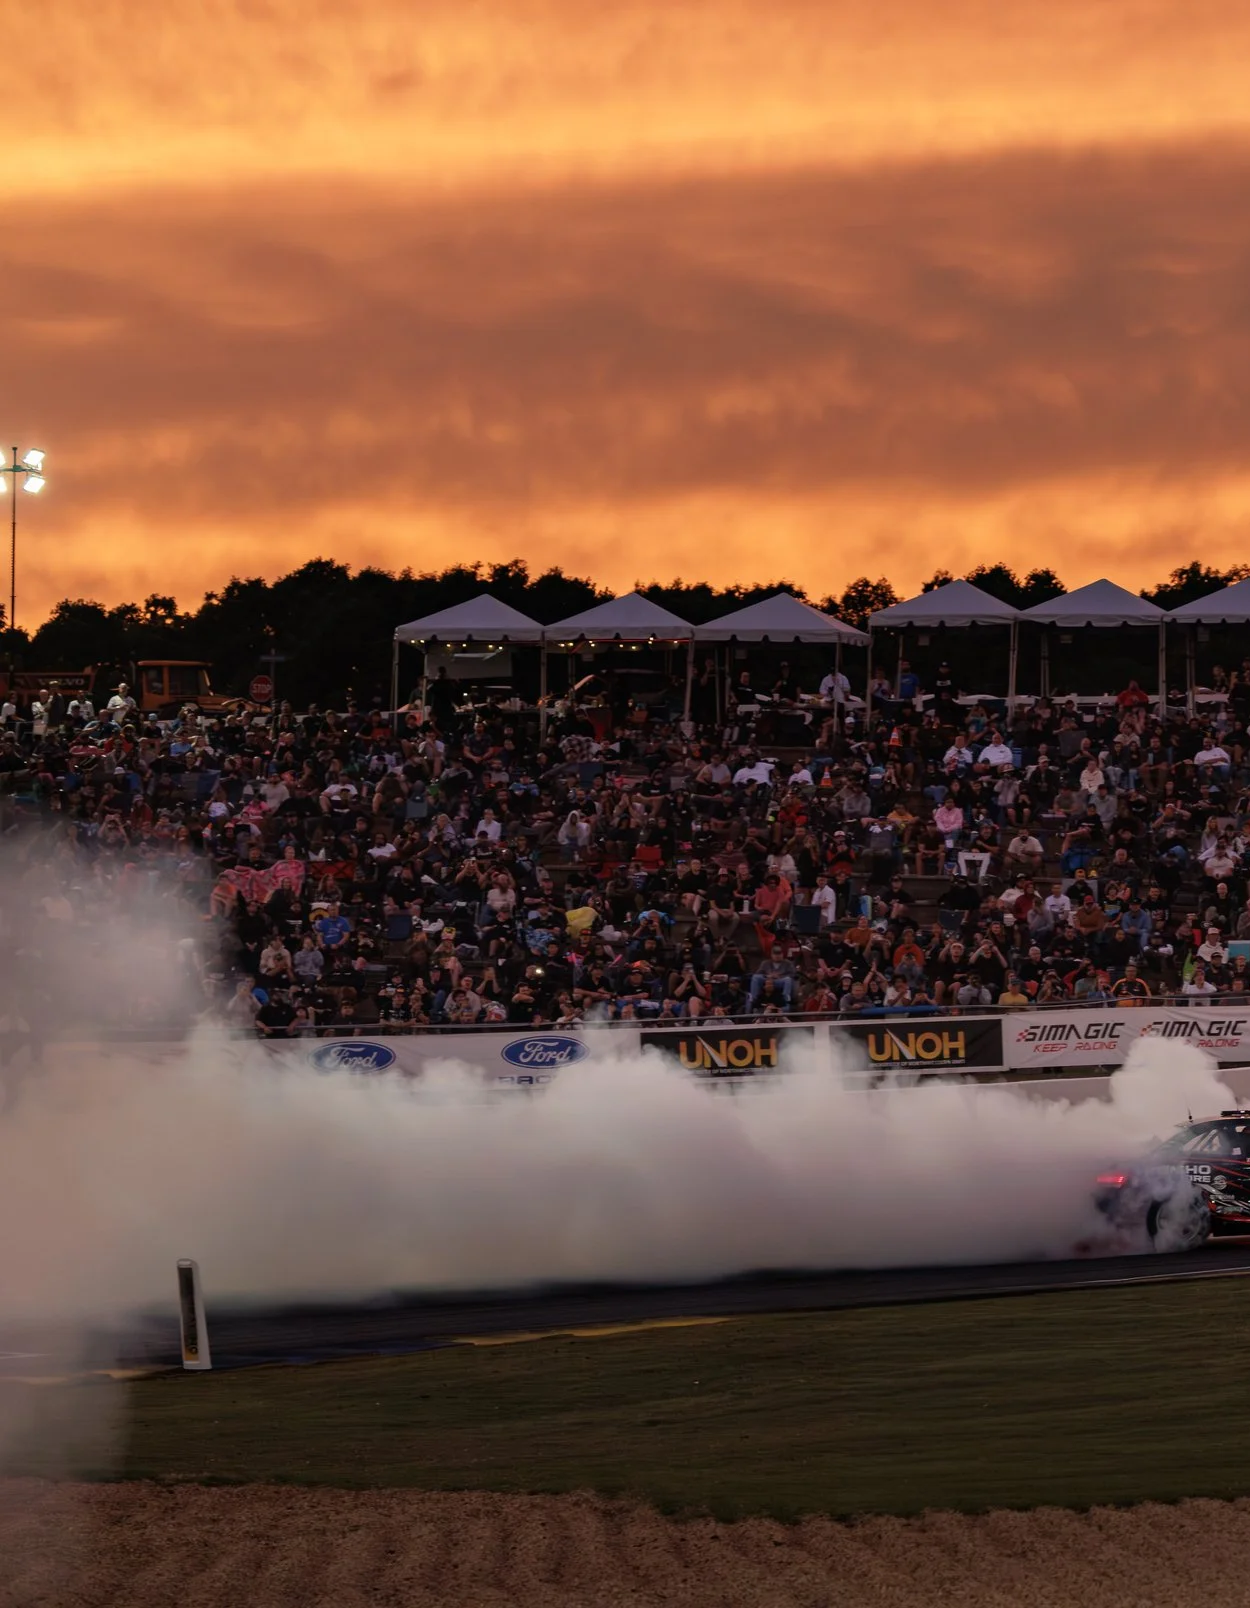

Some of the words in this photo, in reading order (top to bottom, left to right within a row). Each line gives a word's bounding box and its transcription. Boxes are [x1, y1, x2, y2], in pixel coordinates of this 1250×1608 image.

[252, 683, 272, 694] STOP
[1025, 1023, 1125, 1042] SIMAGIC
[519, 1041, 571, 1063] Ford
[680, 1035, 778, 1068] UNOH
[868, 1028, 965, 1061] UNOH
[1033, 1043, 1068, 1053] KEEP
[1074, 1041, 1118, 1051] RACING
[1197, 1038, 1240, 1048] RACING
[327, 1047, 378, 1068] Ford
